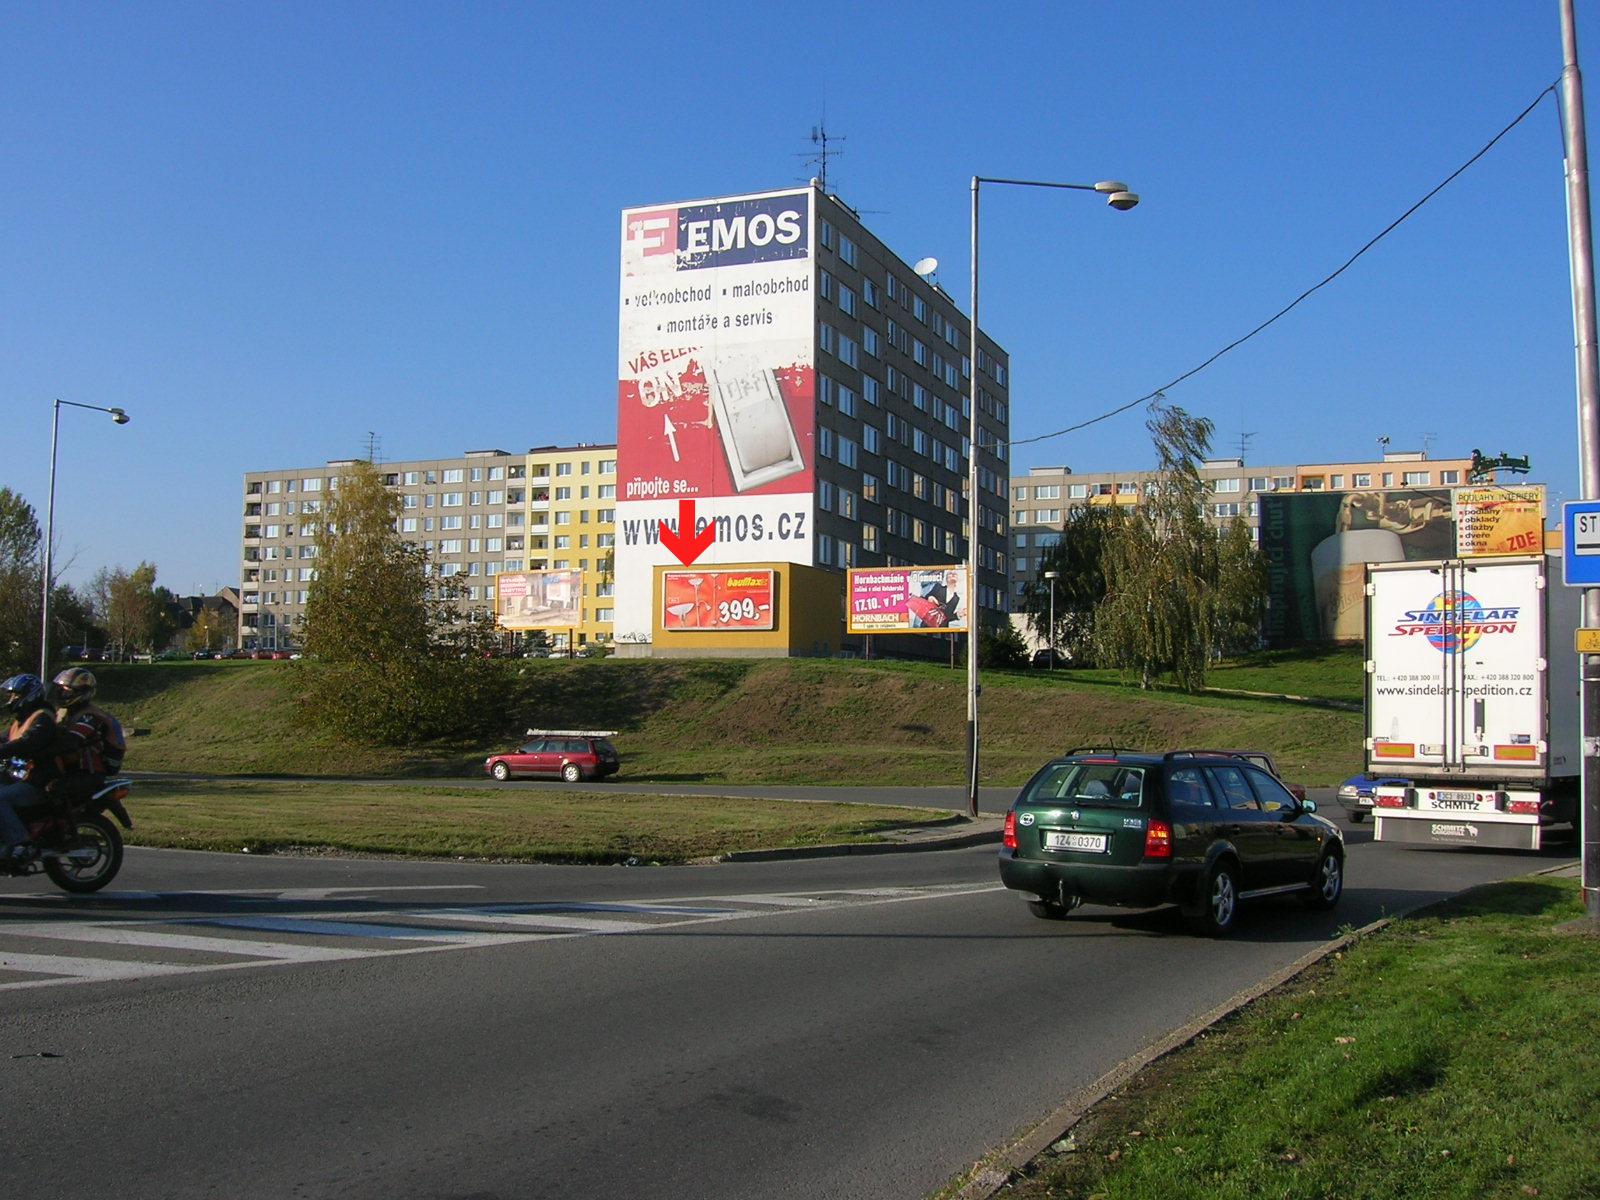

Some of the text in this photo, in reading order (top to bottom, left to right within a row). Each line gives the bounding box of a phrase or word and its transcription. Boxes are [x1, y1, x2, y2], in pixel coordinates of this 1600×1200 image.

[687, 210, 801, 254] EMOS
[732, 275, 809, 298] maloobchod
[666, 308, 773, 333] montáže a servis
[626, 476, 699, 499] připojte se...
[623, 512, 806, 546] wwwemos.cz
[1464, 516, 1500, 524] obklady
[1506, 531, 1537, 552] ZDE
[719, 597, 770, 623] 399,-
[854, 597, 881, 612] 17.10.
[852, 613, 899, 622] HORNBACH
[1399, 607, 1520, 622] SINDELAR
[1390, 622, 1518, 636] SPEDITION
[1431, 800, 1480, 811] SCHMITZ
[1054, 835, 1101, 848] 1Z4 0370
